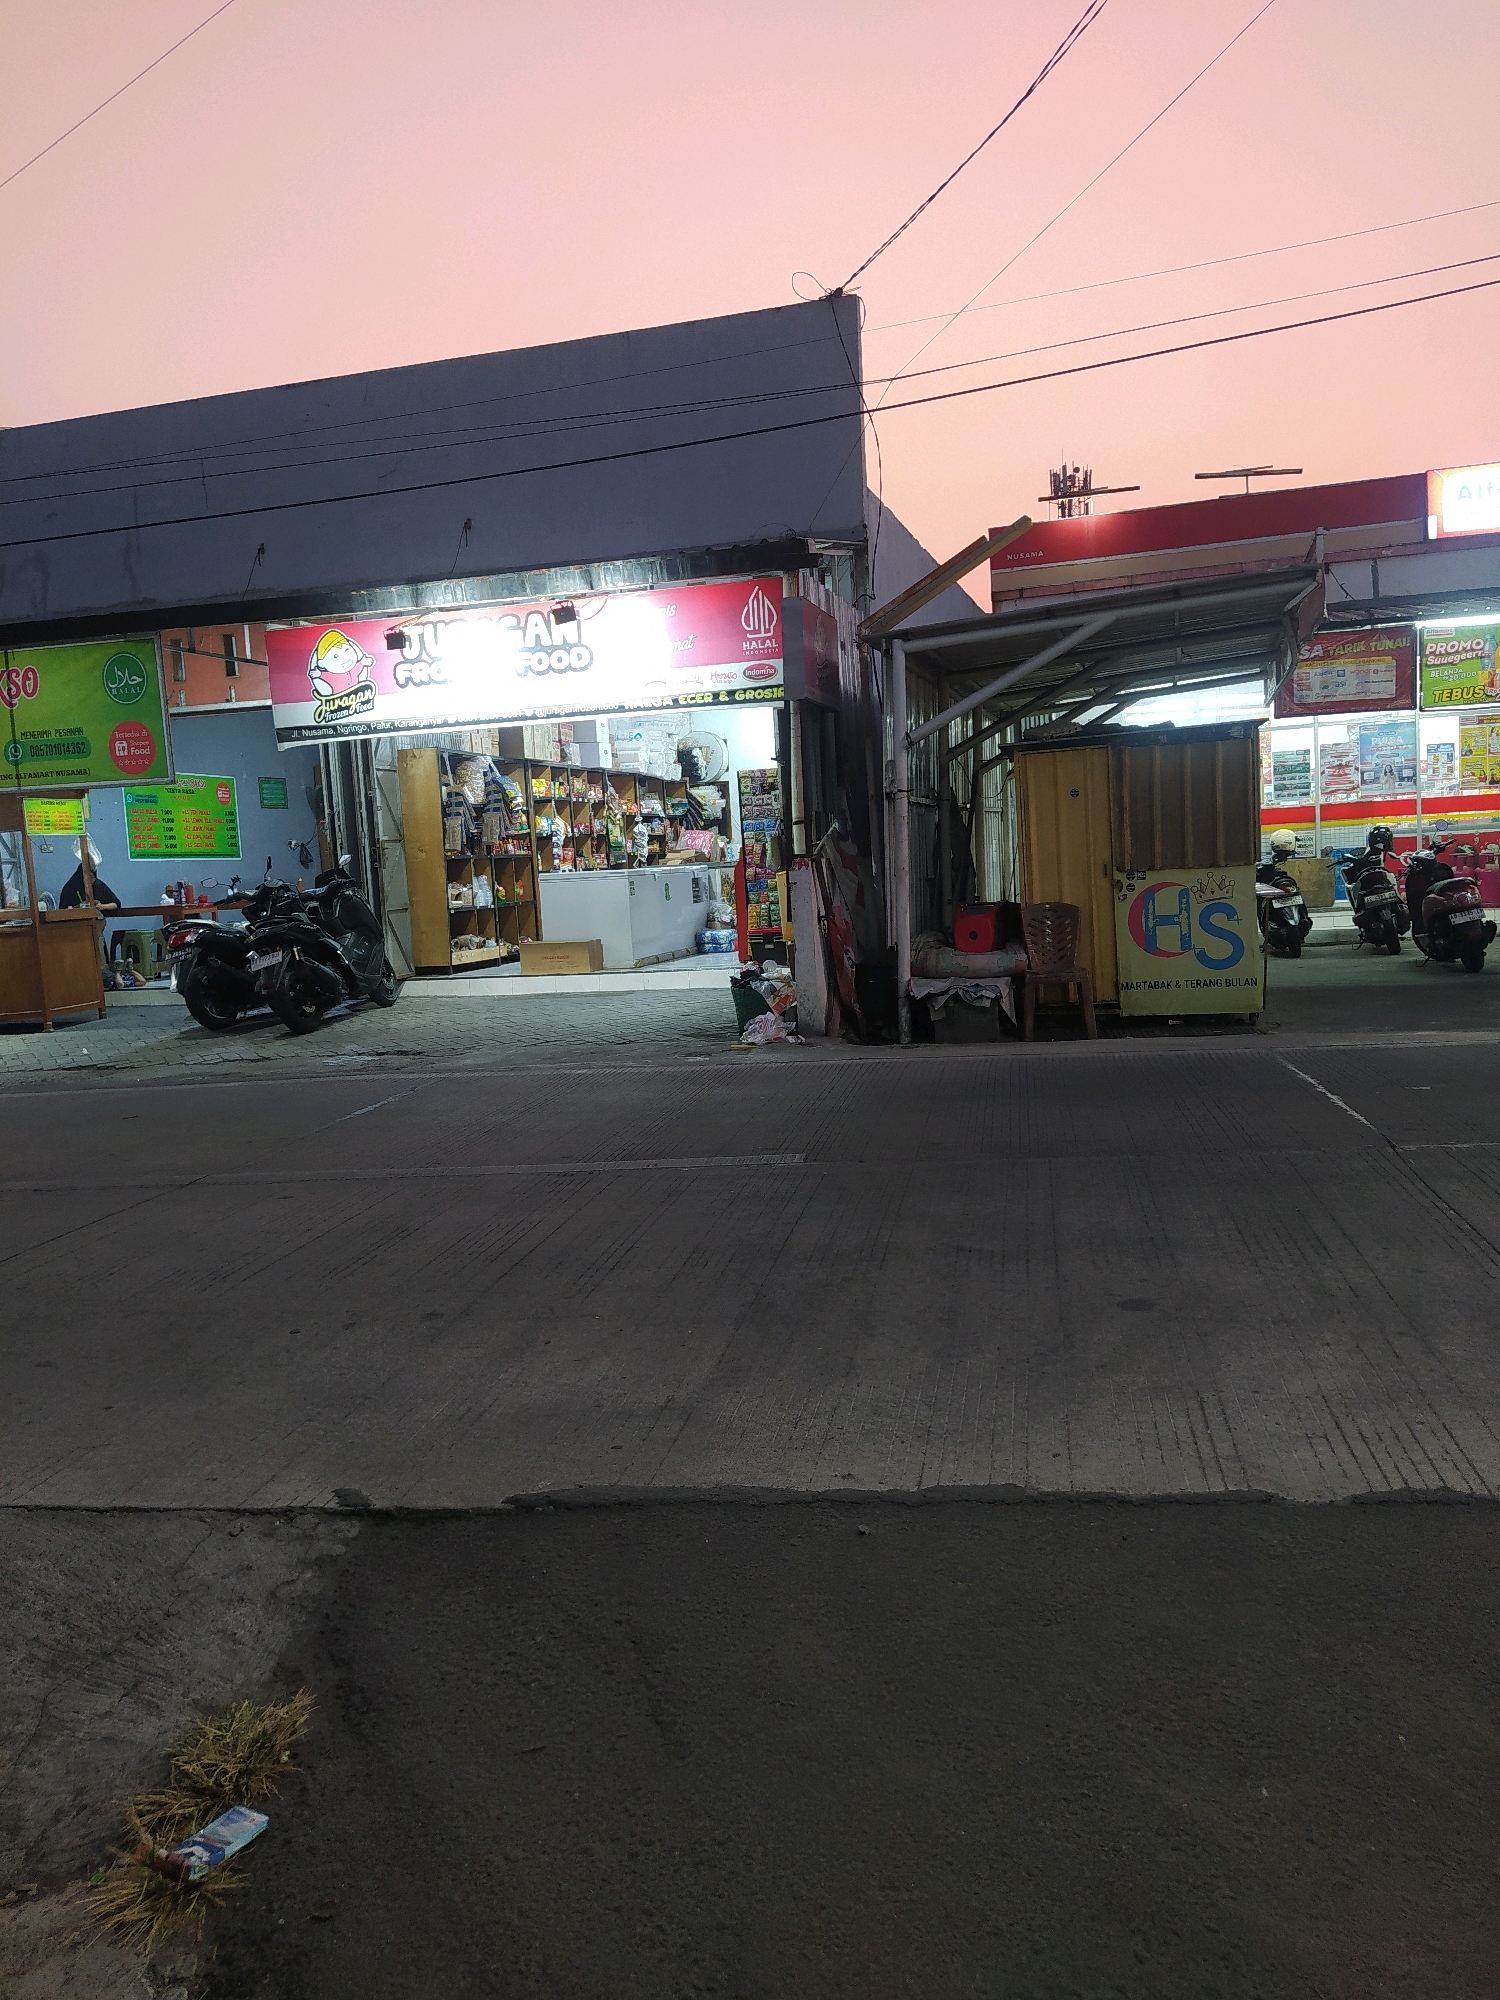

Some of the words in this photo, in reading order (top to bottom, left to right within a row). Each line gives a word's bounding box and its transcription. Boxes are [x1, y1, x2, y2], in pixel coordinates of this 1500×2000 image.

[1006, 550, 1044, 561] NUSAMA
[401, 610, 582, 662] JUGAN
[742, 638, 779, 651] HALAL
[742, 647, 779, 656] INDONESIA
[1327, 640, 1367, 656] TARIK
[1425, 638, 1485, 656] PROMO
[516, 646, 593, 677] FOOD
[107, 665, 143, 688] حلال
[745, 665, 775, 677] Indomina
[1430, 668, 1464, 678] BELANJA
[0, 665, 40, 710] KSO
[111, 686, 142, 695] HALAL
[1433, 685, 1485, 704] TEBUS
[313, 684, 374, 723] Juragan
[302, 727, 336, 738] Nusama,
[337, 724, 370, 735] Ngringo,
[678, 692, 714, 705] ECER
[718, 691, 730, 702] &
[324, 709, 350, 723] Frozen
[355, 702, 374, 714] Food
[20, 728, 52, 740] MENERIMA
[54, 727, 84, 738] PESANAN
[113, 730, 140, 739] Tersedia
[141, 729, 148, 737] di
[130, 746, 151, 756] Food
[55, 768, 91, 777] NUSAMA)
[1121, 978, 1174, 991] MARTABAK
[1175, 979, 1182, 989] &
[1184, 977, 1223, 989] TERANG
[1225, 976, 1258, 988] BULAN
